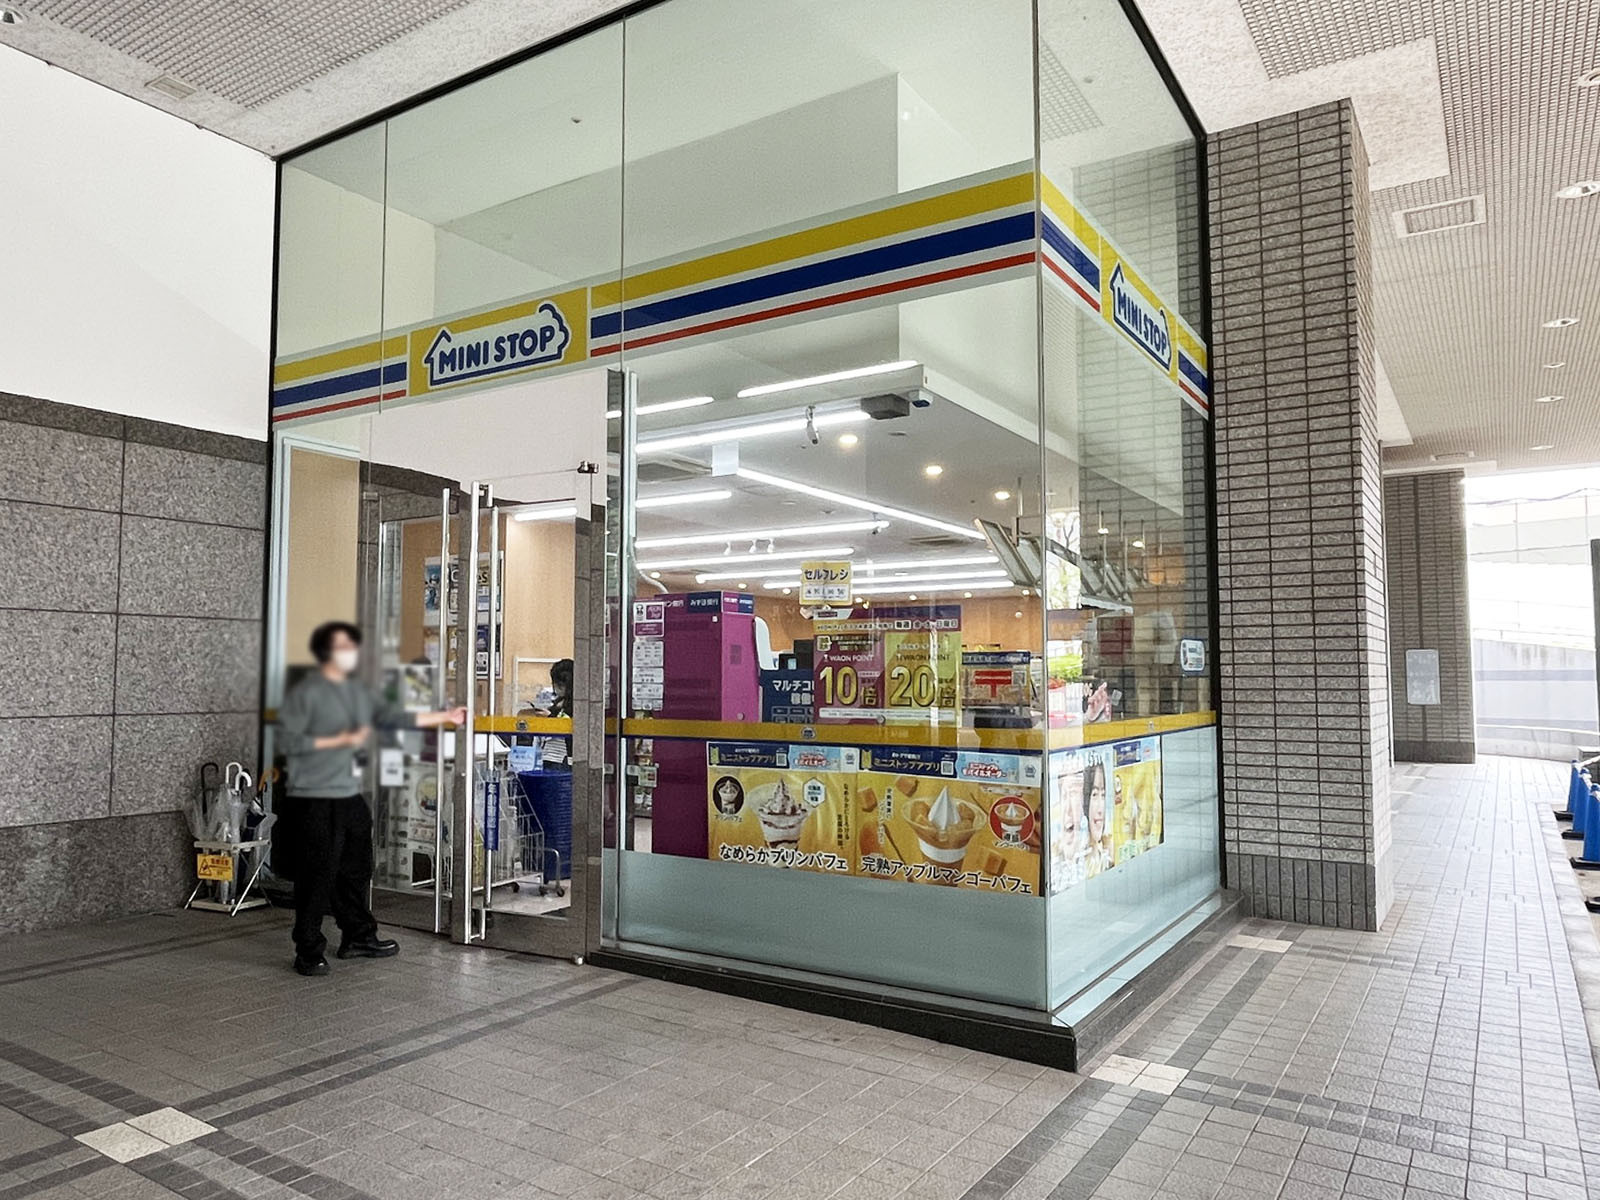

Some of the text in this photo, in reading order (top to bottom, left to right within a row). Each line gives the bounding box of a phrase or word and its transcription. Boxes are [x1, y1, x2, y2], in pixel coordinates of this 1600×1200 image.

[1117, 286, 1167, 356] MINI STOP
[438, 325, 556, 375] MINI STOP
[830, 653, 874, 663] WAON POINT
[772, 679, 815, 692] マルチコ
[873, 757, 940, 772] ミニストップアプリ
[719, 845, 848, 870] なめらかプリンパフェ
[861, 856, 1033, 894] 完熟アップルマンゴーパフェ
